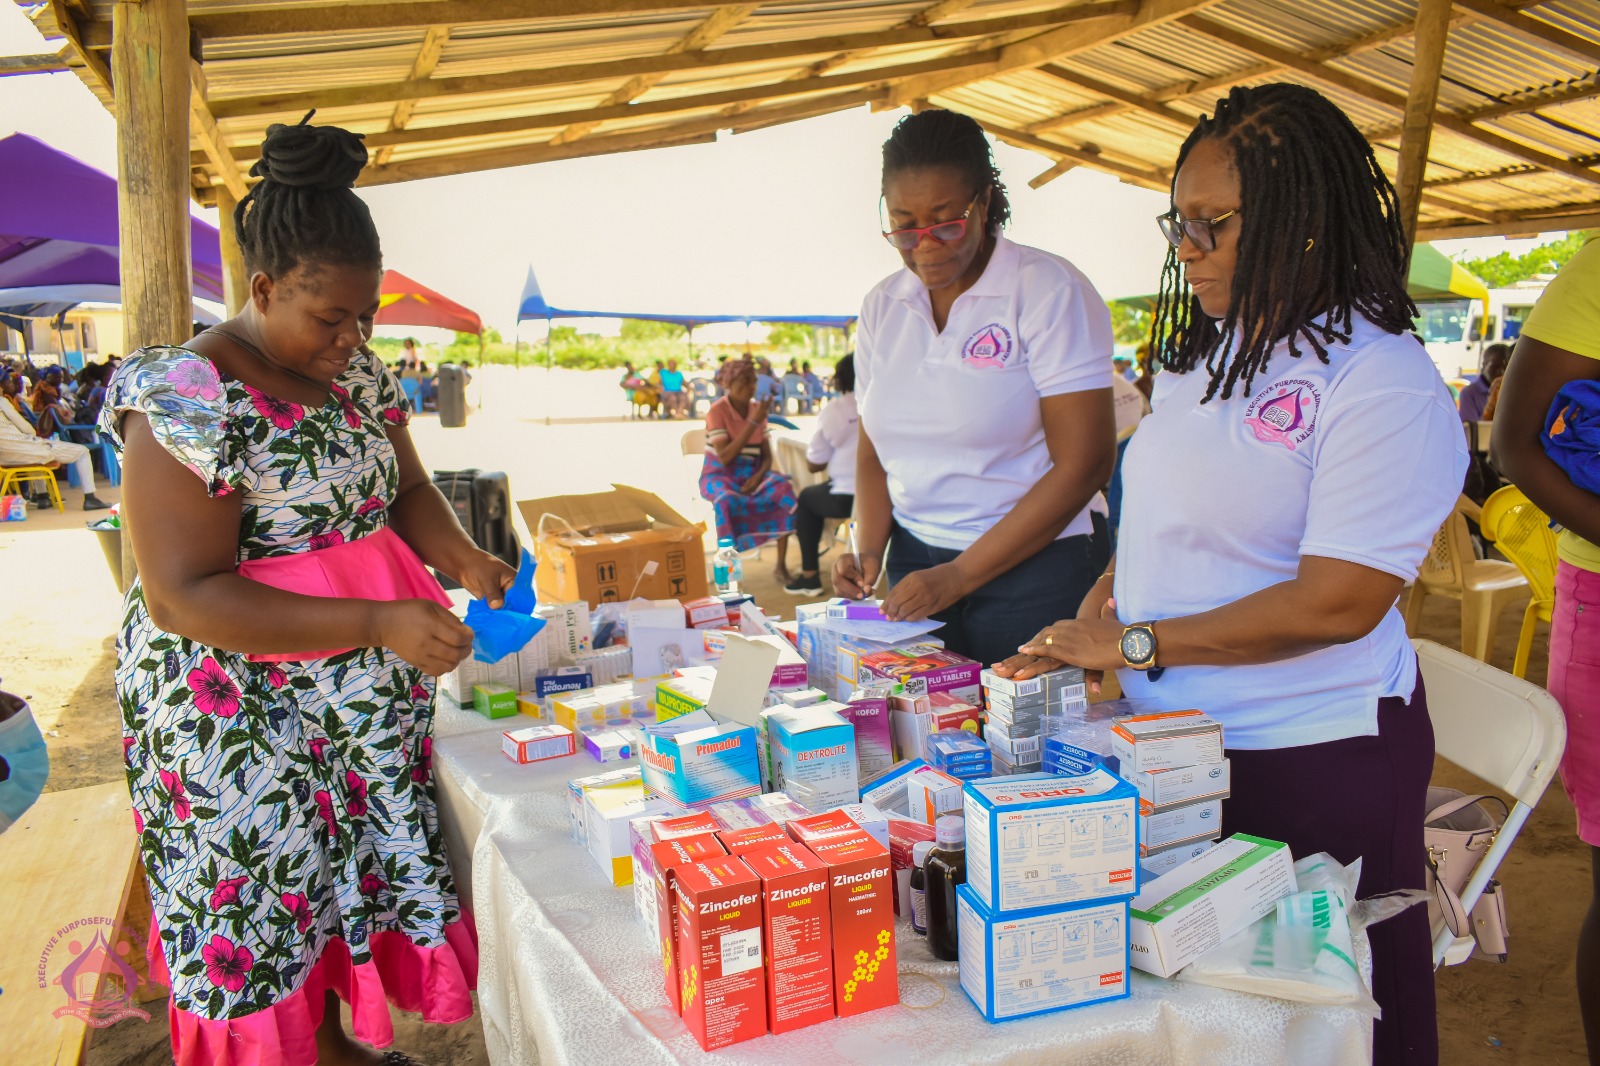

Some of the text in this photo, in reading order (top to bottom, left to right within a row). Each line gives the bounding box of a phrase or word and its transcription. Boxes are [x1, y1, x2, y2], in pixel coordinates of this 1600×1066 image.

[1245, 386, 1274, 417] EXECUTIVE
[1274, 379, 1315, 391] PURPOSEFUL
[568, 630, 576, 654] mino
[905, 679, 924, 688] Salo
[927, 671, 972, 685] FLU TABLETS
[542, 682, 581, 693] Neuropat
[855, 708, 880, 717] KOFOF
[695, 736, 740, 756] Primadol
[797, 744, 846, 762] DEXTROLITE
[1062, 745, 1088, 757] AZIROCIN
[641, 744, 676, 773] Primadol
[1059, 757, 1083, 770] AZIROCIN
[1019, 787, 1086, 799] ORS
[815, 836, 869, 852] Zincofer
[777, 845, 807, 870] Zincofer
[696, 863, 723, 887] Zincofer
[833, 867, 889, 887] Zincofer
[770, 881, 827, 901] Zincofer
[851, 883, 872, 893] LIQUID
[700, 894, 758, 915] Zincofer
[787, 897, 812, 909] LIQUIDE
[720, 910, 741, 921] LIQUID
[705, 996, 725, 1005] apex
